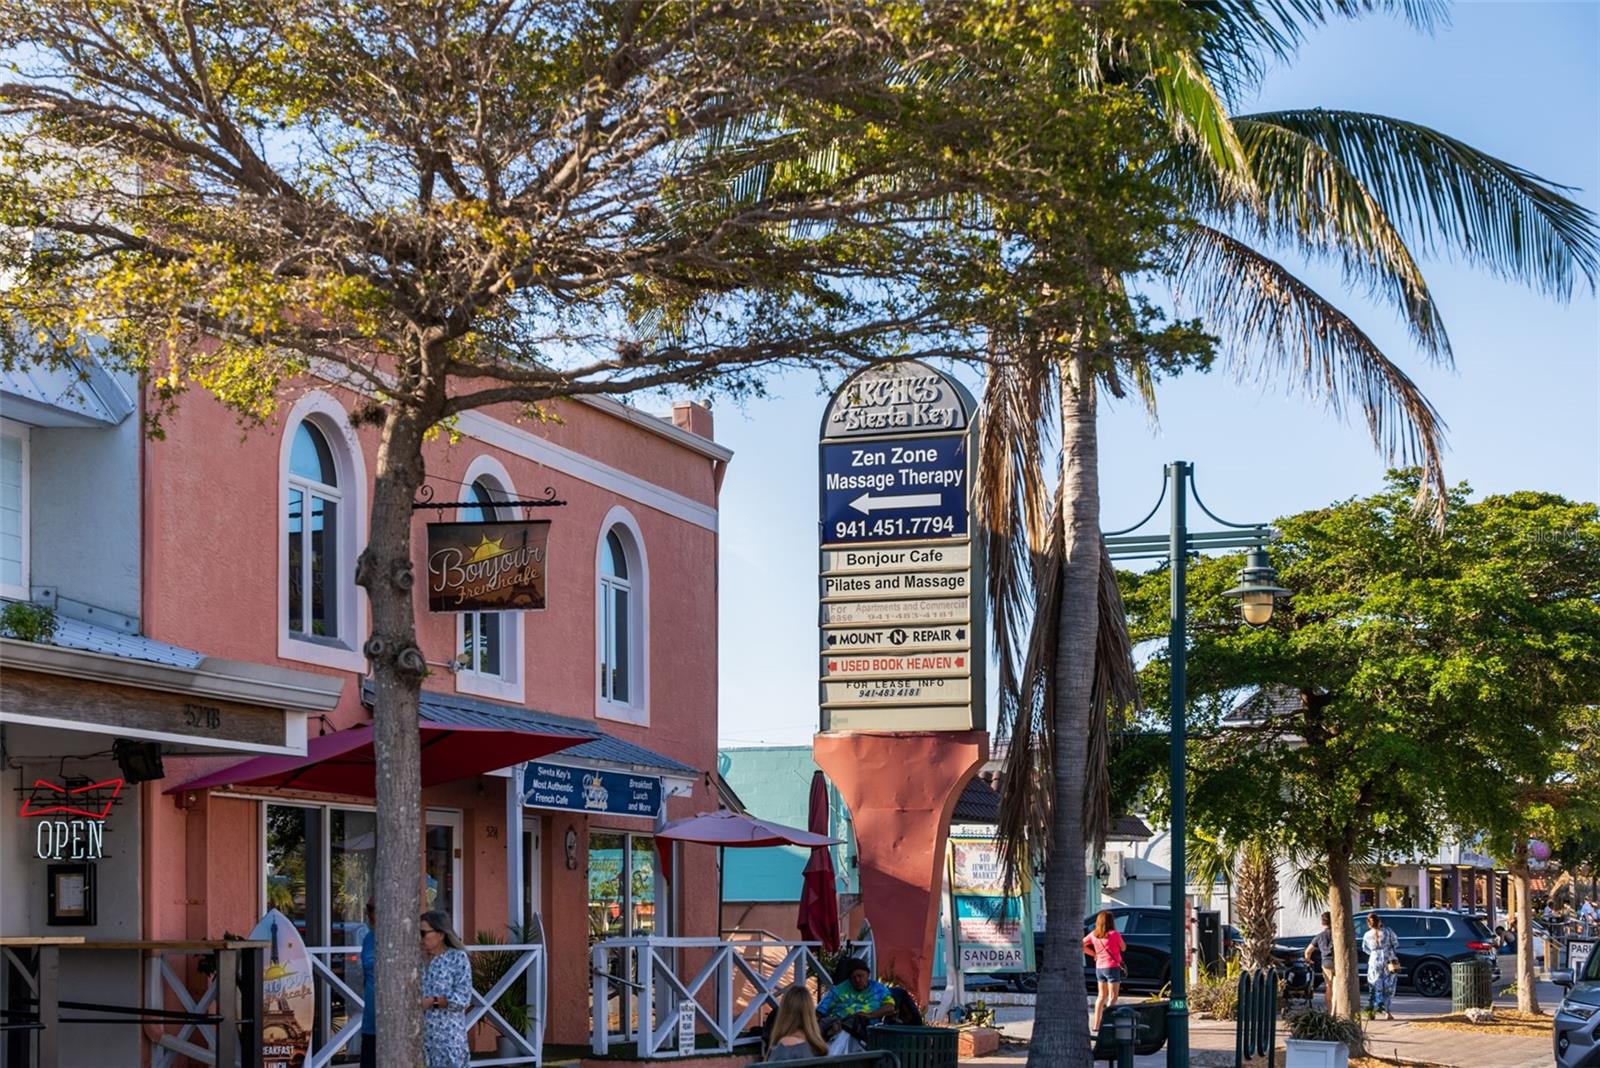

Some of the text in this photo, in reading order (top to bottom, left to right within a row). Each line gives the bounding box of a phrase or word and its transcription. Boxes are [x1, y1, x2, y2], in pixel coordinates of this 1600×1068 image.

[846, 405, 909, 431] Siesta
[914, 403, 955, 429] Key
[851, 447, 938, 467] Zen Zone
[826, 469, 963, 491] Massage Therapy
[835, 516, 954, 538] 941.451.7794
[847, 549, 943, 567] Bonjour Cafe
[429, 548, 542, 592] Bonjour
[826, 575, 965, 592] Pilates and Massage
[831, 599, 968, 614] For Apartments and Commercial
[839, 632, 883, 645] MOUNT
[913, 630, 952, 642] REPAIR
[841, 657, 952, 672] USED BOOK HEAVEN
[846, 679, 945, 689] FOR LEASE INFO
[537, 767, 571, 780] Siesta Key's
[533, 780, 574, 792] Most Authentic
[629, 779, 653, 790] Breakfast
[535, 793, 569, 805] French Cafe
[633, 791, 649, 800] Lunch
[628, 802, 651, 812] and More
[37, 820, 105, 860] OPEN
[964, 951, 1021, 961] SANDBAR
